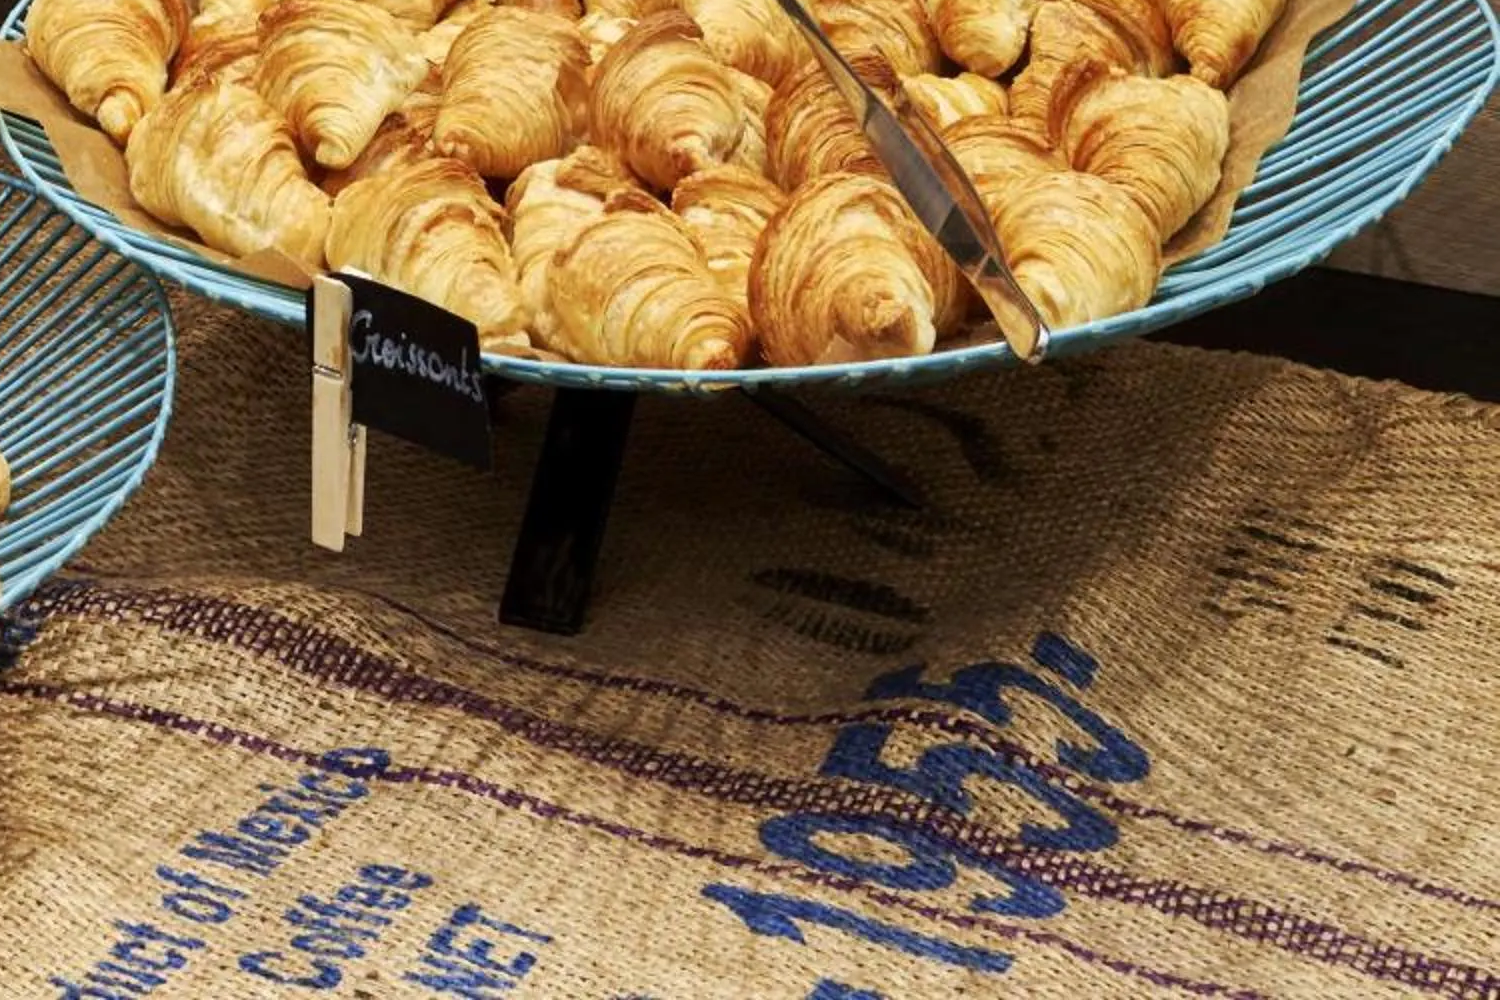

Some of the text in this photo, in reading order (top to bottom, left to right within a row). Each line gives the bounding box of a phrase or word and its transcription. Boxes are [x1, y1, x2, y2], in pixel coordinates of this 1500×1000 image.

[178, 747, 392, 877] Mexico
[237, 864, 434, 989] Coffee
[402, 902, 555, 1000] NET
